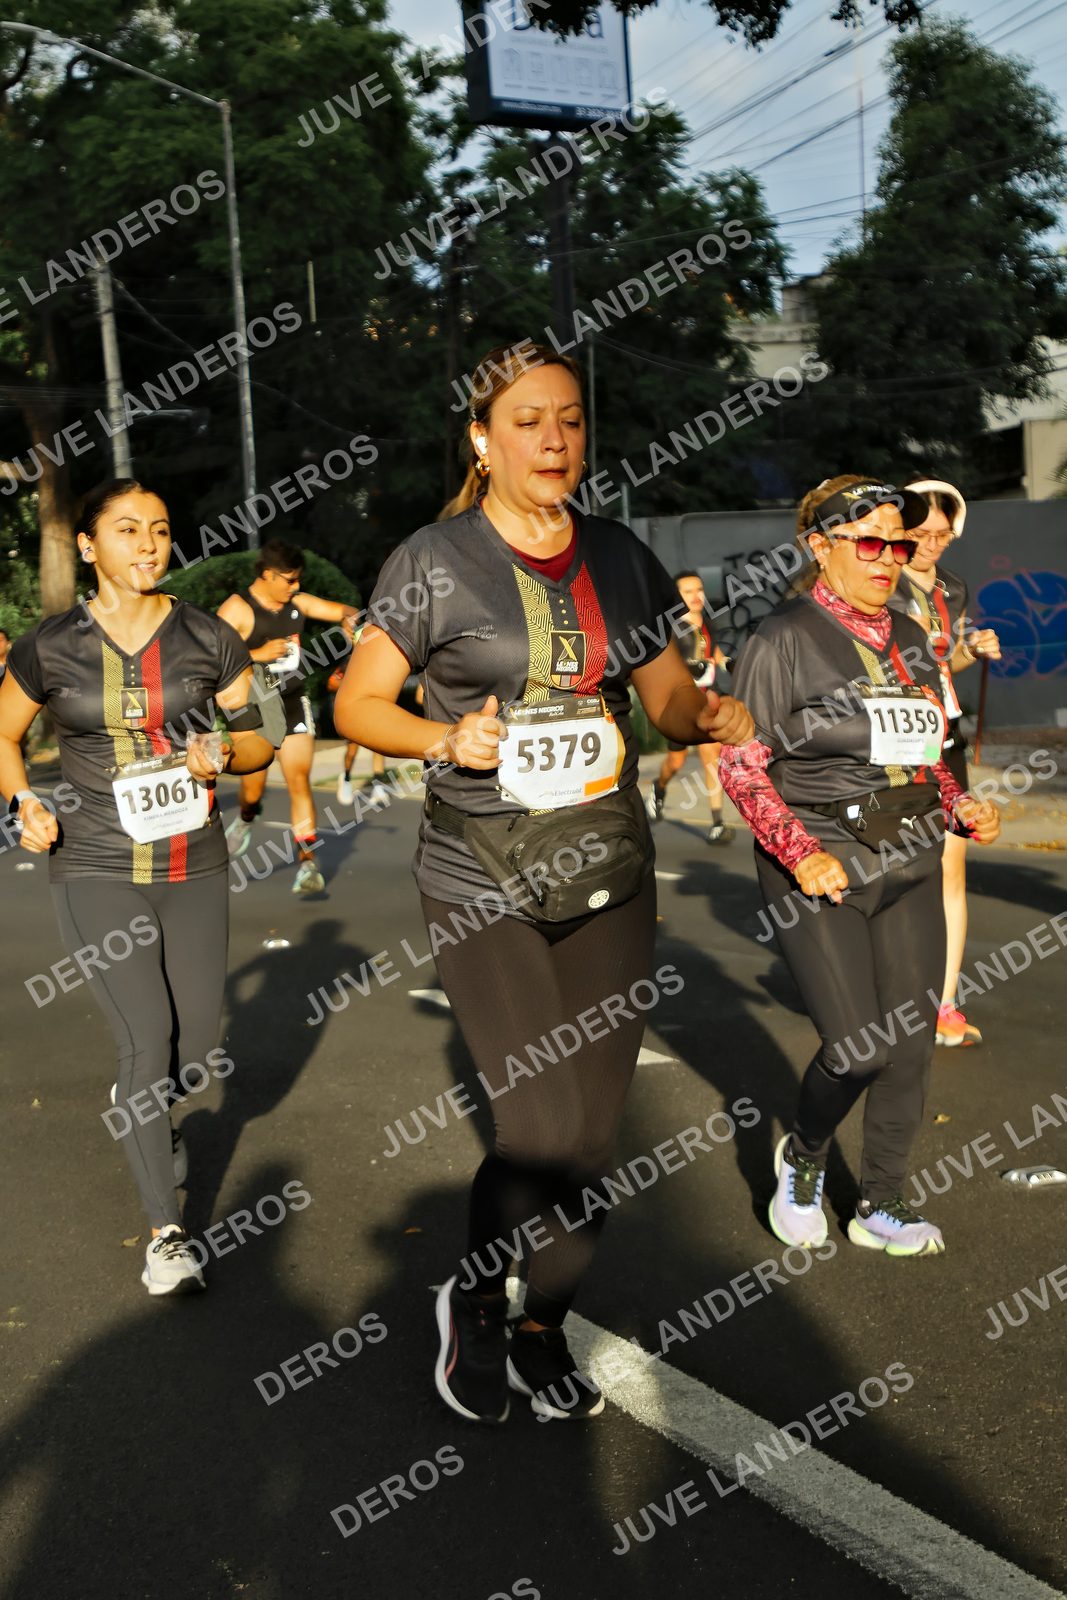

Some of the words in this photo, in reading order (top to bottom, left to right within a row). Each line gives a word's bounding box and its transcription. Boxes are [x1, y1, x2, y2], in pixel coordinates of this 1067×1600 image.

[873, 707, 940, 735] 11359
[517, 731, 602, 774] 5379
[121, 776, 199, 814] 13061
